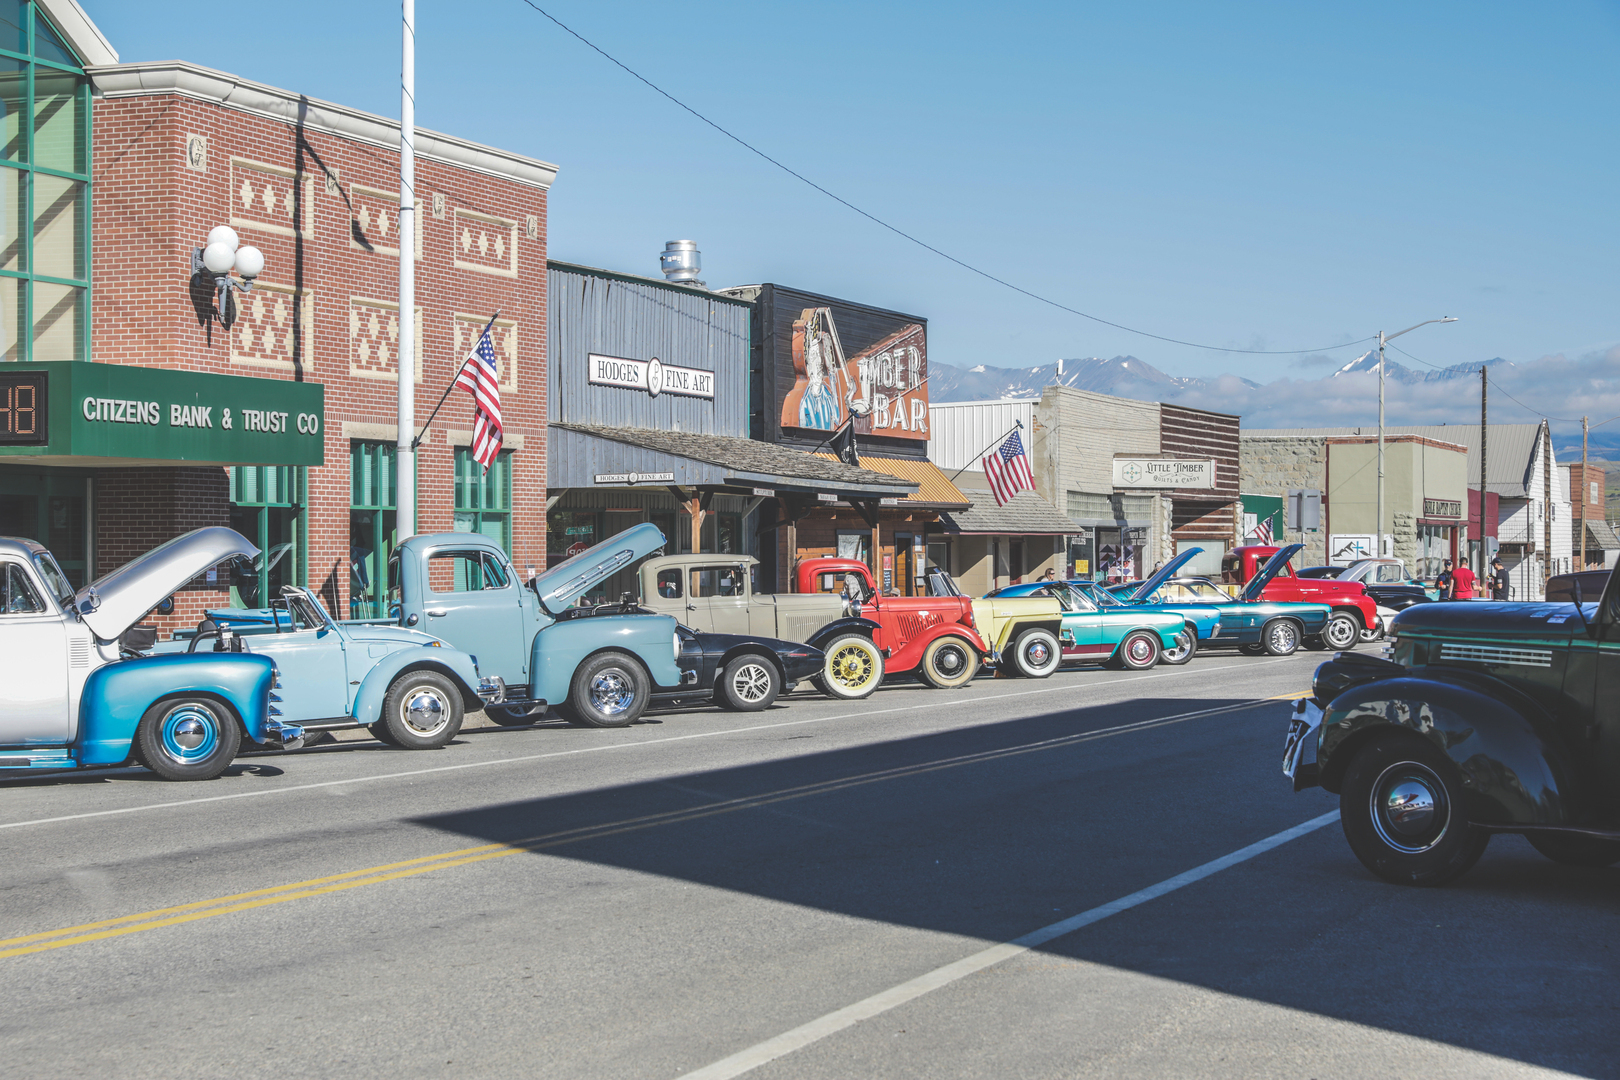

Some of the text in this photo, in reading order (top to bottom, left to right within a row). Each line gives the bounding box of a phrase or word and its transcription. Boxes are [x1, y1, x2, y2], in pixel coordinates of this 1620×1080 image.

[597, 360, 711, 393] HODGES FINE ART
[83, 396, 319, 435] CITIZENS BANK & TRUST CO
[872, 393, 928, 434] BAR
[1145, 462, 1204, 474] LITTLE TIMBER
